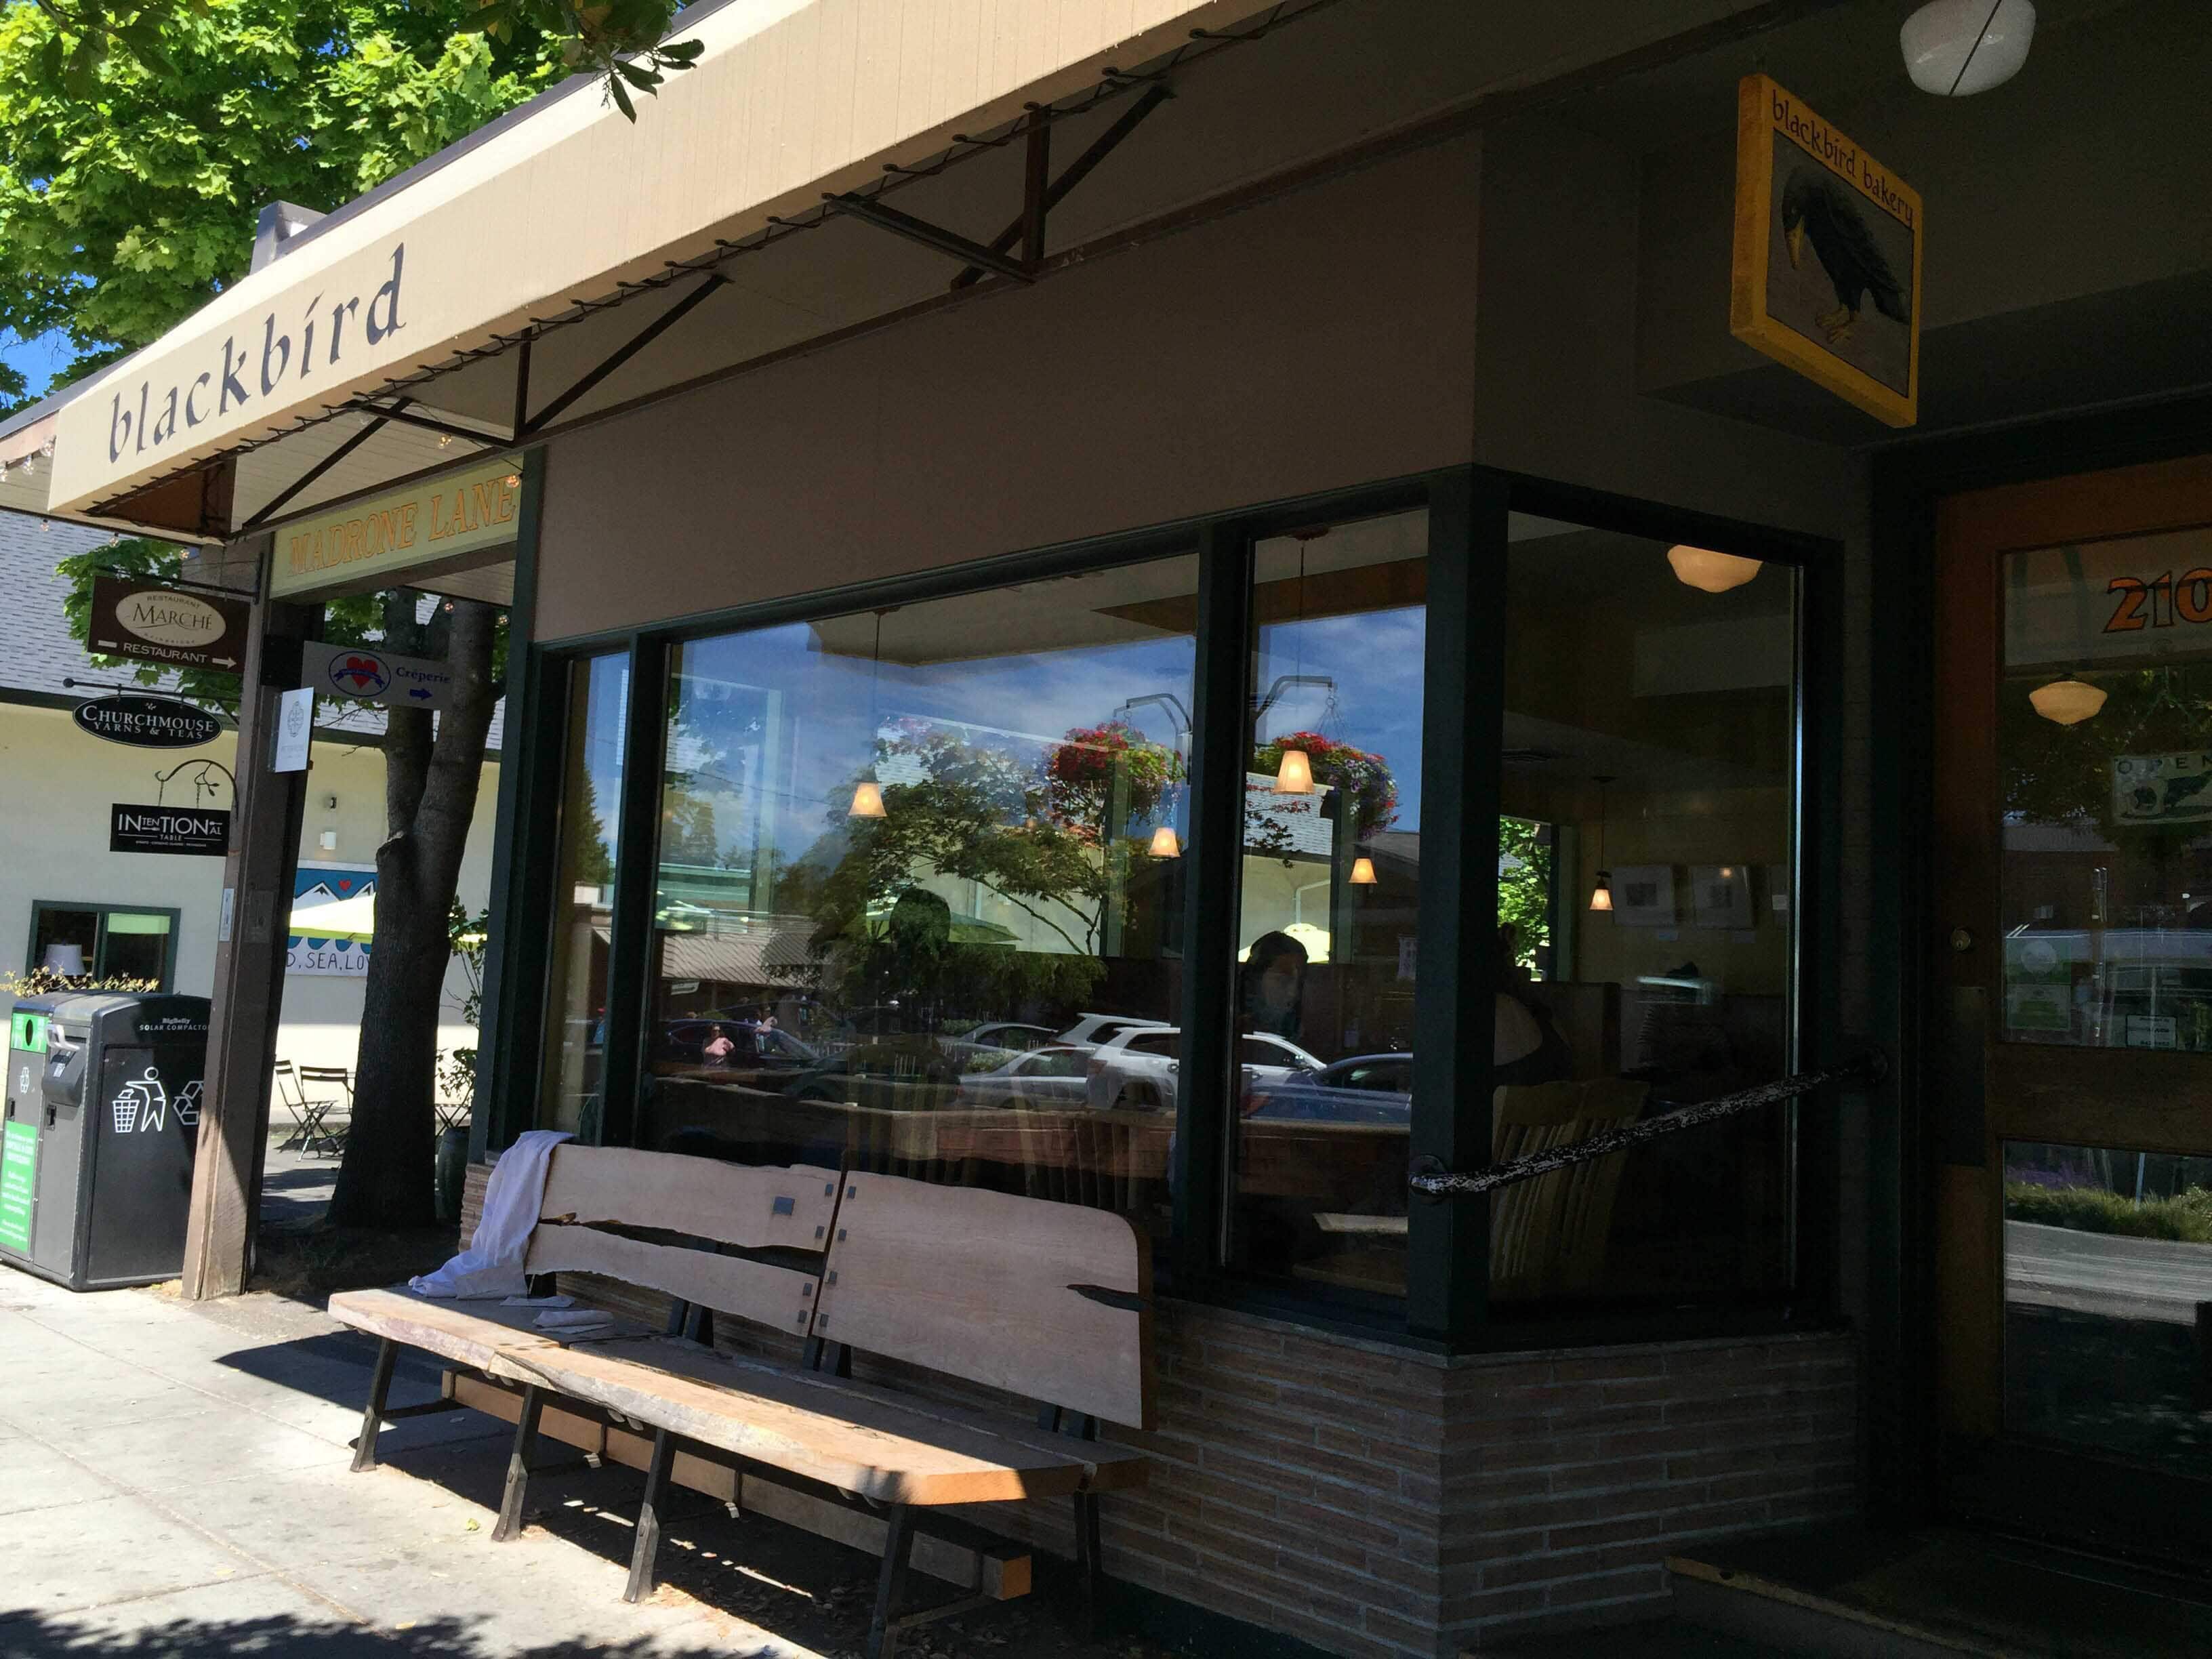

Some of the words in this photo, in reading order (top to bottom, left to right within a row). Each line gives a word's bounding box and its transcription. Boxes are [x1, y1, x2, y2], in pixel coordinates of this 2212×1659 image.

[1772, 89, 1857, 180] blackbird
[1863, 160, 1914, 228] bakery
[108, 242, 407, 464] blackbird
[289, 502, 418, 576] MADRONE
[428, 474, 516, 541] LANE
[146, 594, 201, 609] RESTAURANT
[2102, 567, 2212, 634] 210
[123, 642, 208, 663] RESTAURANT
[82, 705, 215, 733] CHURCHMOUSE
[94, 722, 142, 734] YARNS
[149, 726, 160, 736] &
[168, 729, 203, 740] TEAS
[160, 834, 183, 842] TABLE
